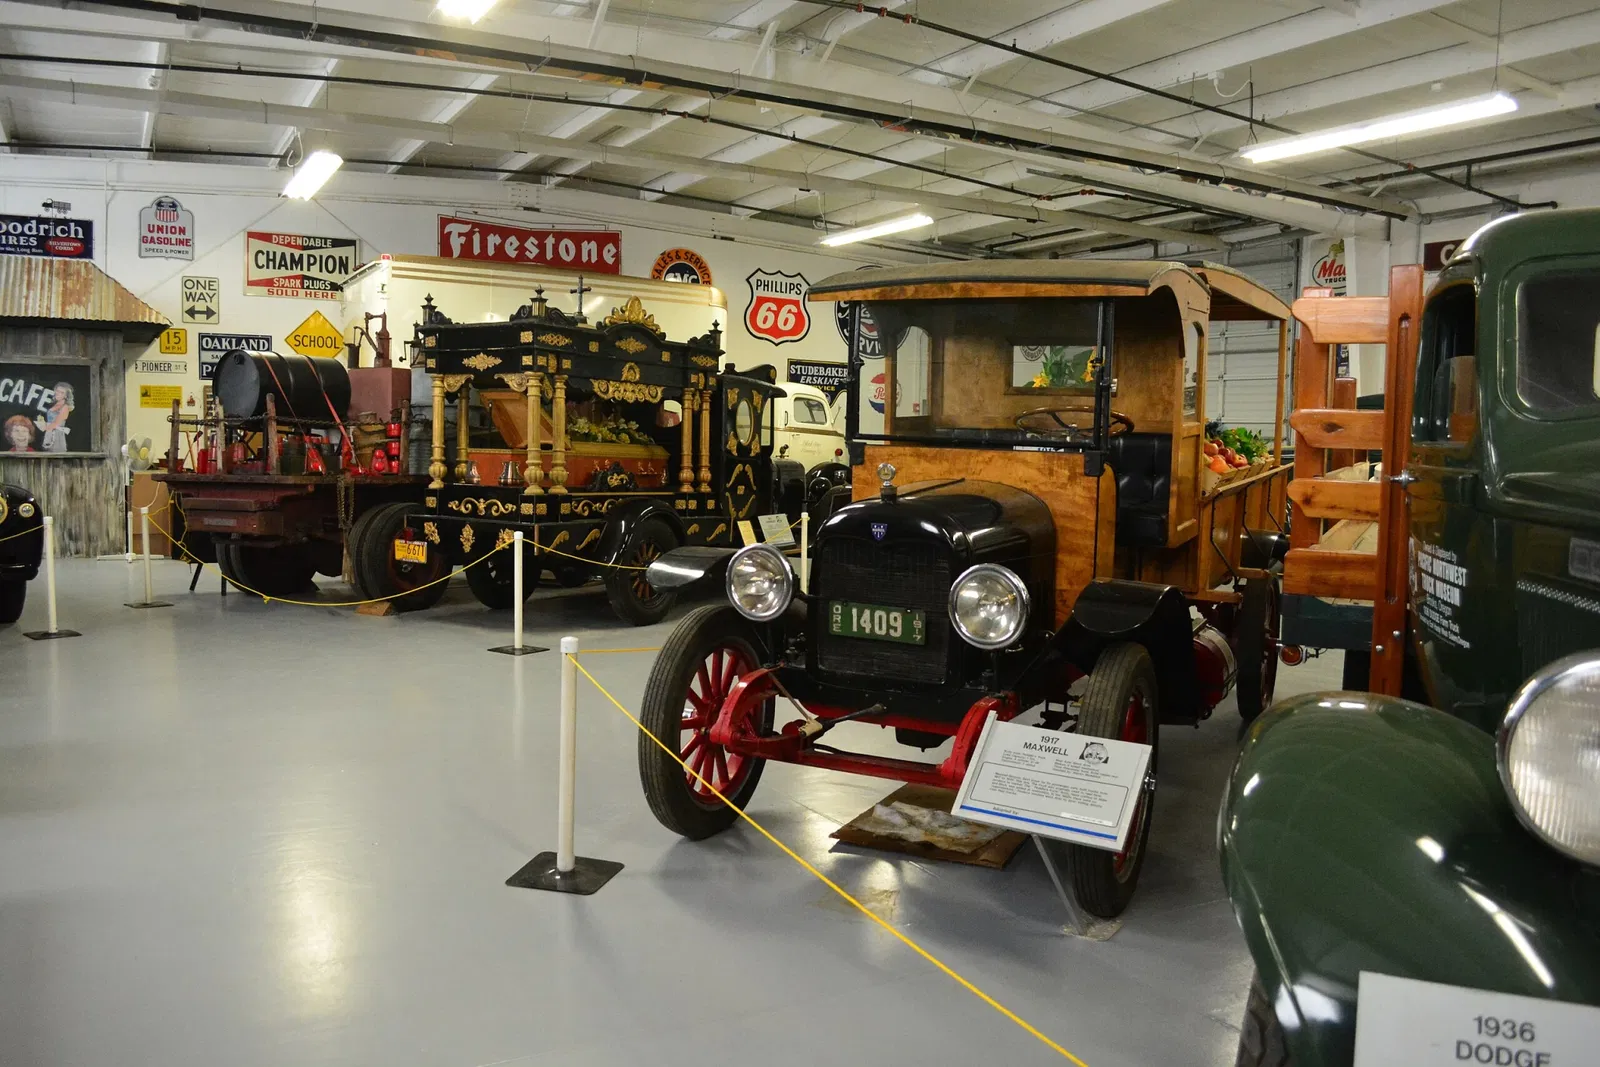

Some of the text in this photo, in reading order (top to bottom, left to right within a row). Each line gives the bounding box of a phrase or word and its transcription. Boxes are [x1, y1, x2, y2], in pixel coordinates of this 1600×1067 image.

[147, 223, 186, 236] UNION
[142, 235, 191, 247] GASOLINE
[272, 235, 332, 248] DEPENDABLE
[444, 223, 617, 265] Firestone
[254, 249, 349, 275] CHAMPION
[653, 250, 711, 285] SALES & SERVICE
[184, 279, 217, 291] ONE
[273, 278, 331, 290] SPARK PLUGS
[756, 279, 802, 296] PHILLIPS
[185, 291, 217, 303] WAY
[267, 288, 337, 299] SOLD HERE
[756, 302, 798, 331] 66
[166, 331, 181, 345] 15
[202, 336, 269, 351] OAKLAND
[294, 334, 339, 349] SCHOOL
[141, 362, 172, 372] PIONEER
[790, 365, 848, 377] STUDEBAKER
[800, 375, 839, 386] ERSKINE
[0, 378, 55, 413] CAFE
[833, 605, 842, 632] ORE
[851, 607, 902, 637] 1409
[913, 613, 922, 642] 1917
[1041, 735, 1060, 745] 1917
[1023, 741, 1069, 756] MAXWELL
[1474, 1015, 1536, 1043] 1936
[1455, 1040, 1552, 1067] DODGE
